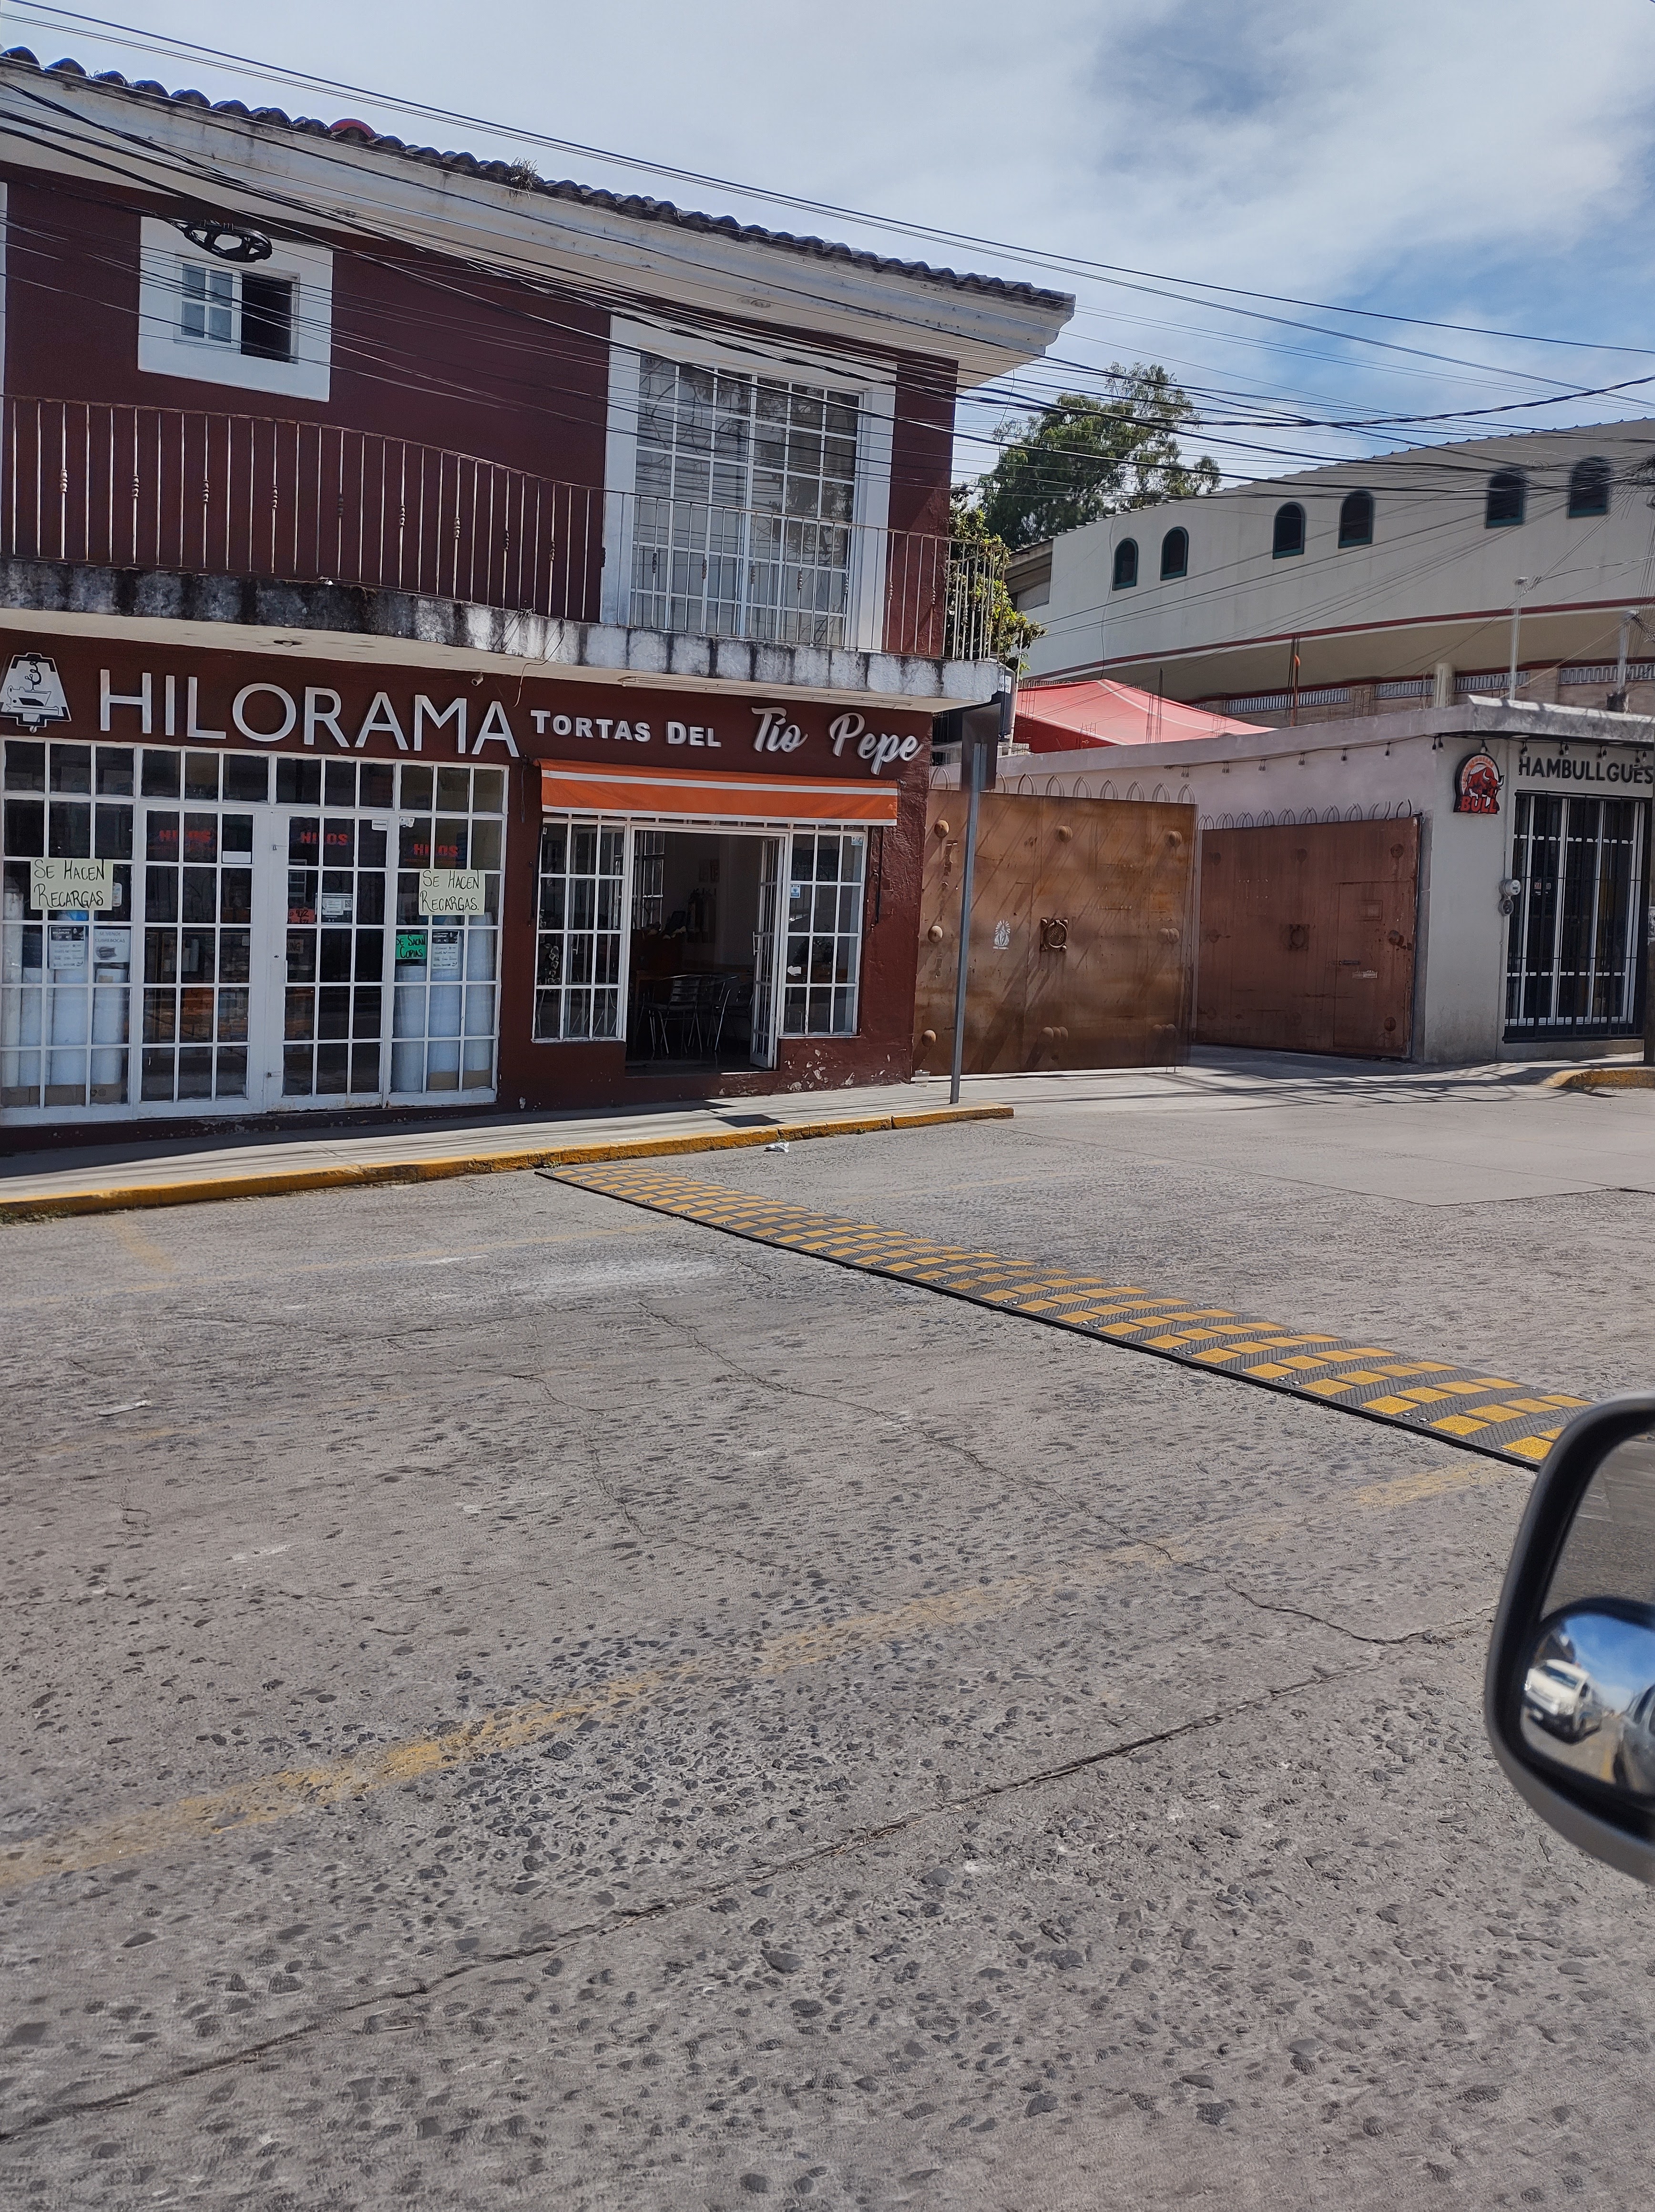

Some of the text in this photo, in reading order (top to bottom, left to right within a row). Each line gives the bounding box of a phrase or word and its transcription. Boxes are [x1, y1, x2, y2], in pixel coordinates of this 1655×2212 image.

[100, 669, 520, 758] HILORAMA
[530, 709, 651, 743] TORTAS
[667, 721, 722, 748] DEL
[828, 712, 925, 776] Pepe
[1460, 795, 1497, 813] BULL
[34, 858, 105, 881] SE HACEN
[422, 869, 480, 890] SE HACEN
[33, 883, 104, 909] RECARGAS
[419, 890, 480, 913] RECARGAS.
[399, 946, 423, 959] COPIAS
